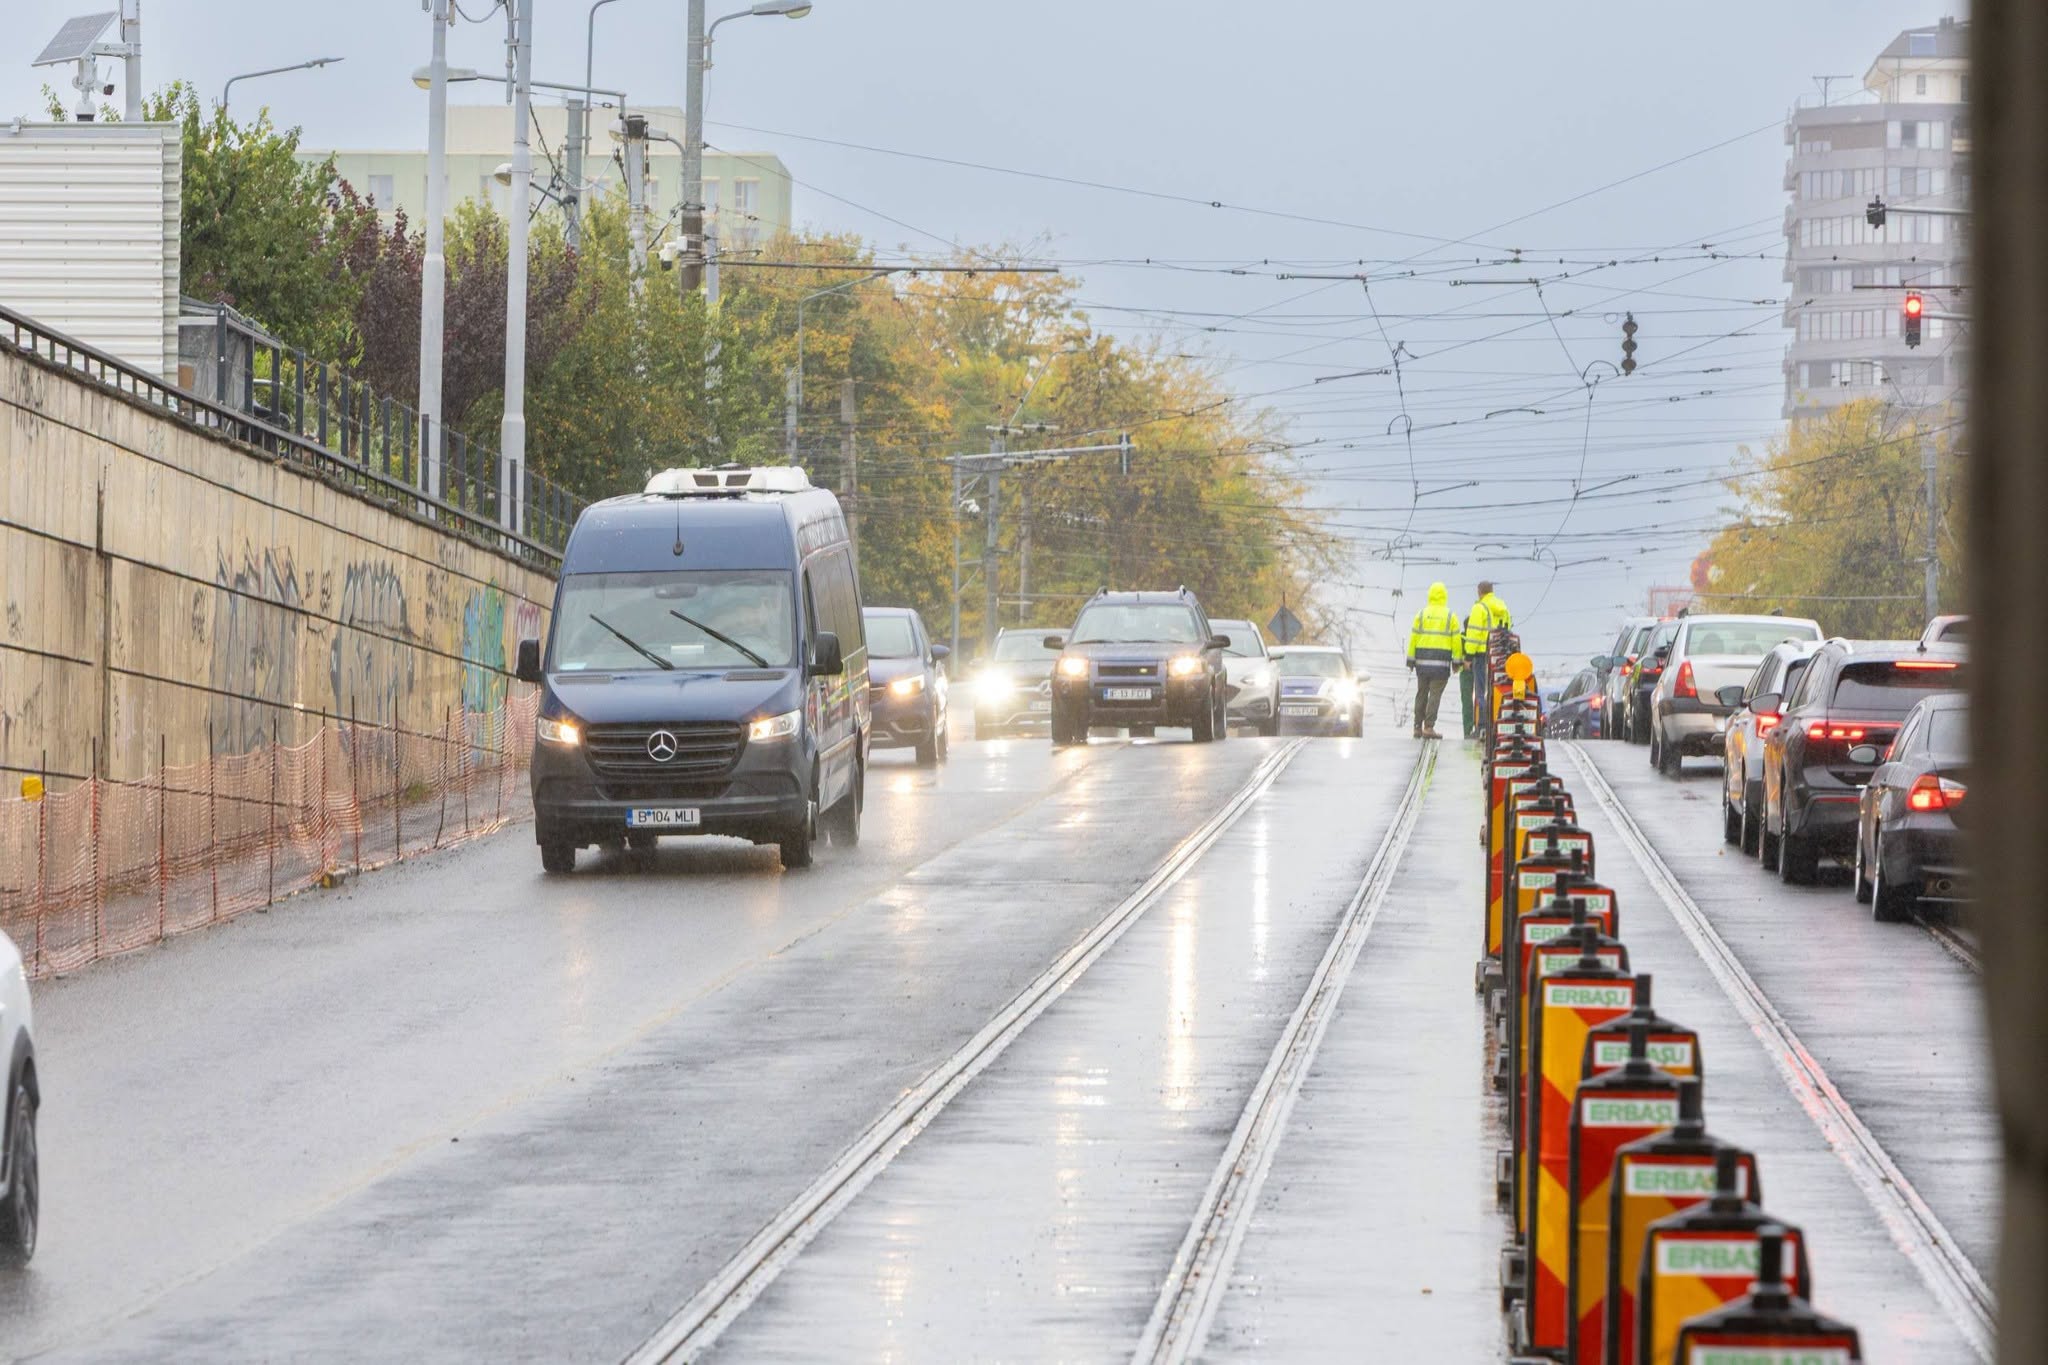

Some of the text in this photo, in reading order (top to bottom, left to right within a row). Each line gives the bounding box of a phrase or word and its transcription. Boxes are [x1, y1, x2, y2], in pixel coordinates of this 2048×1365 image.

[638, 811, 694, 822] B 104 MLI
